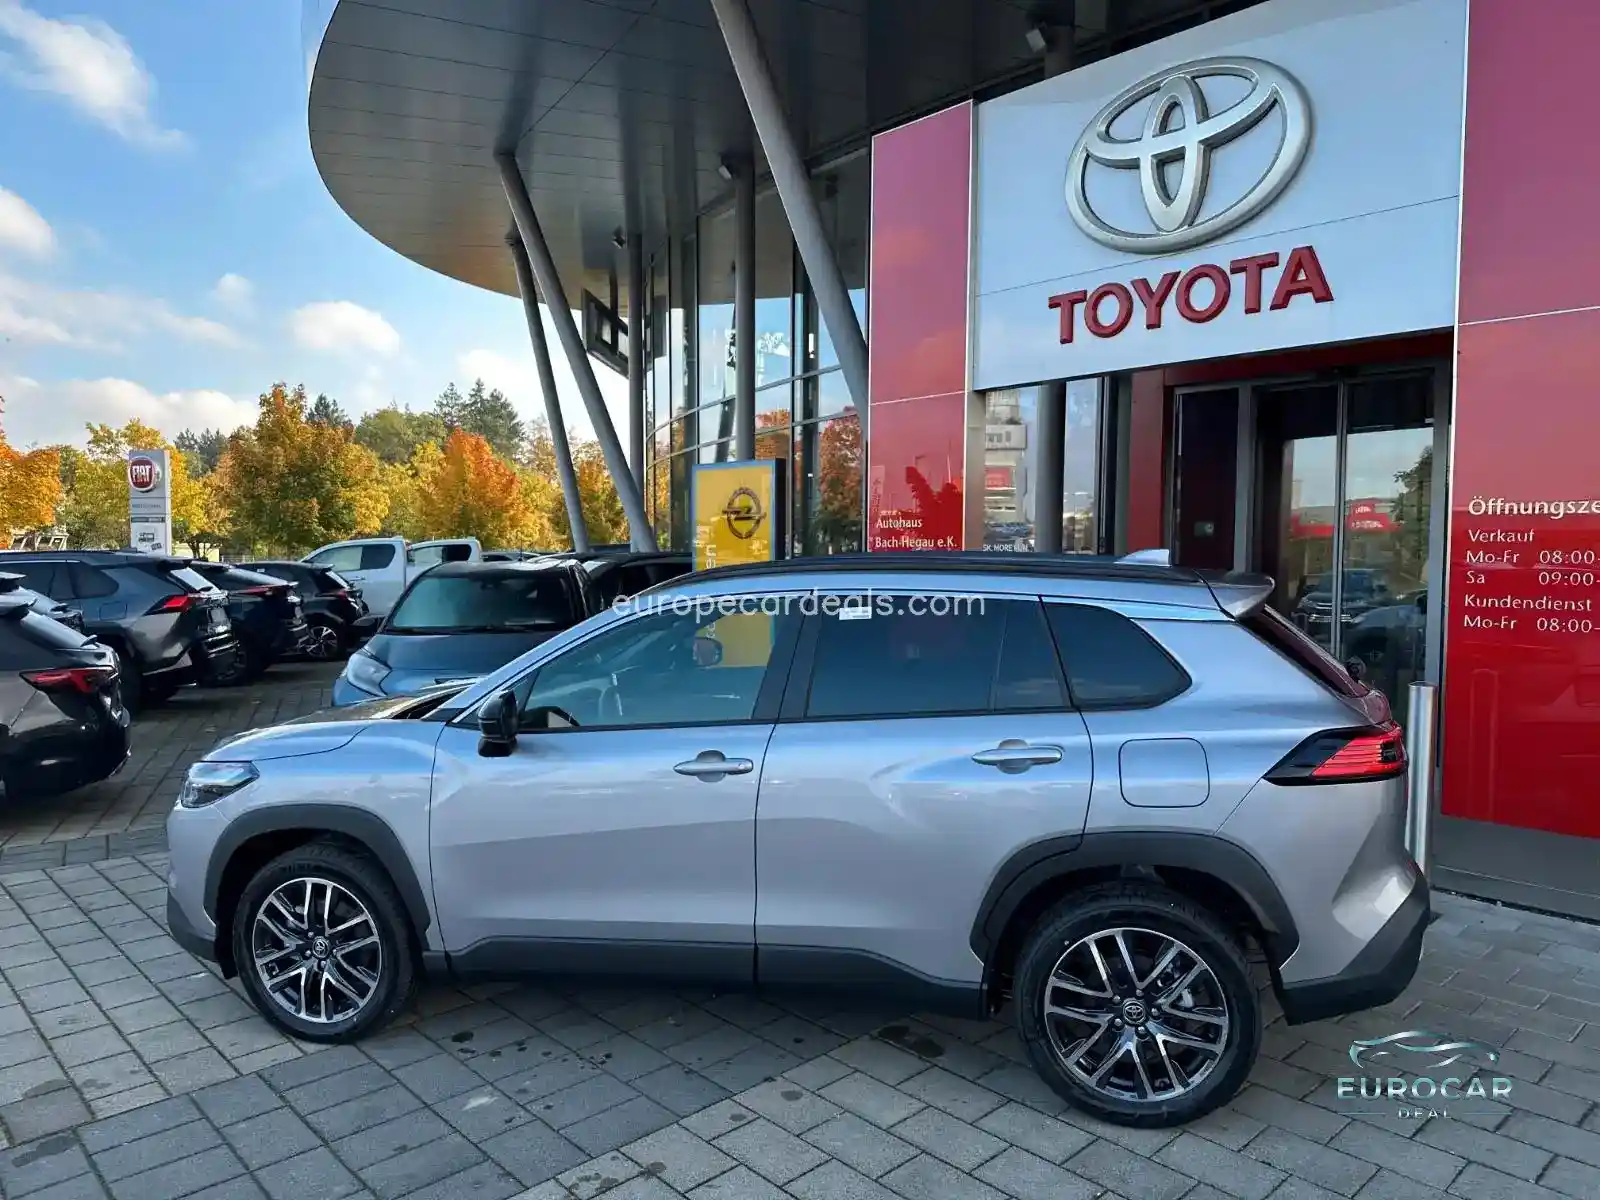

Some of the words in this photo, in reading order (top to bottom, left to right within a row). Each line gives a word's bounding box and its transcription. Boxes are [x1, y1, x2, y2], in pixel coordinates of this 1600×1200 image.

[1048, 245, 1334, 344] TOYOTA
[131, 465, 151, 482] FIAT
[876, 517, 923, 529] Autohaus
[875, 536, 934, 550] Bach-Hegau
[937, 535, 958, 548] e.K.
[1468, 529, 1535, 543] Verkauf
[1466, 550, 1520, 563] Mo-Fr
[1466, 570, 1485, 584] Sa
[1464, 594, 1592, 612] Kundendienst
[1464, 615, 1517, 630] Mo-Fr
